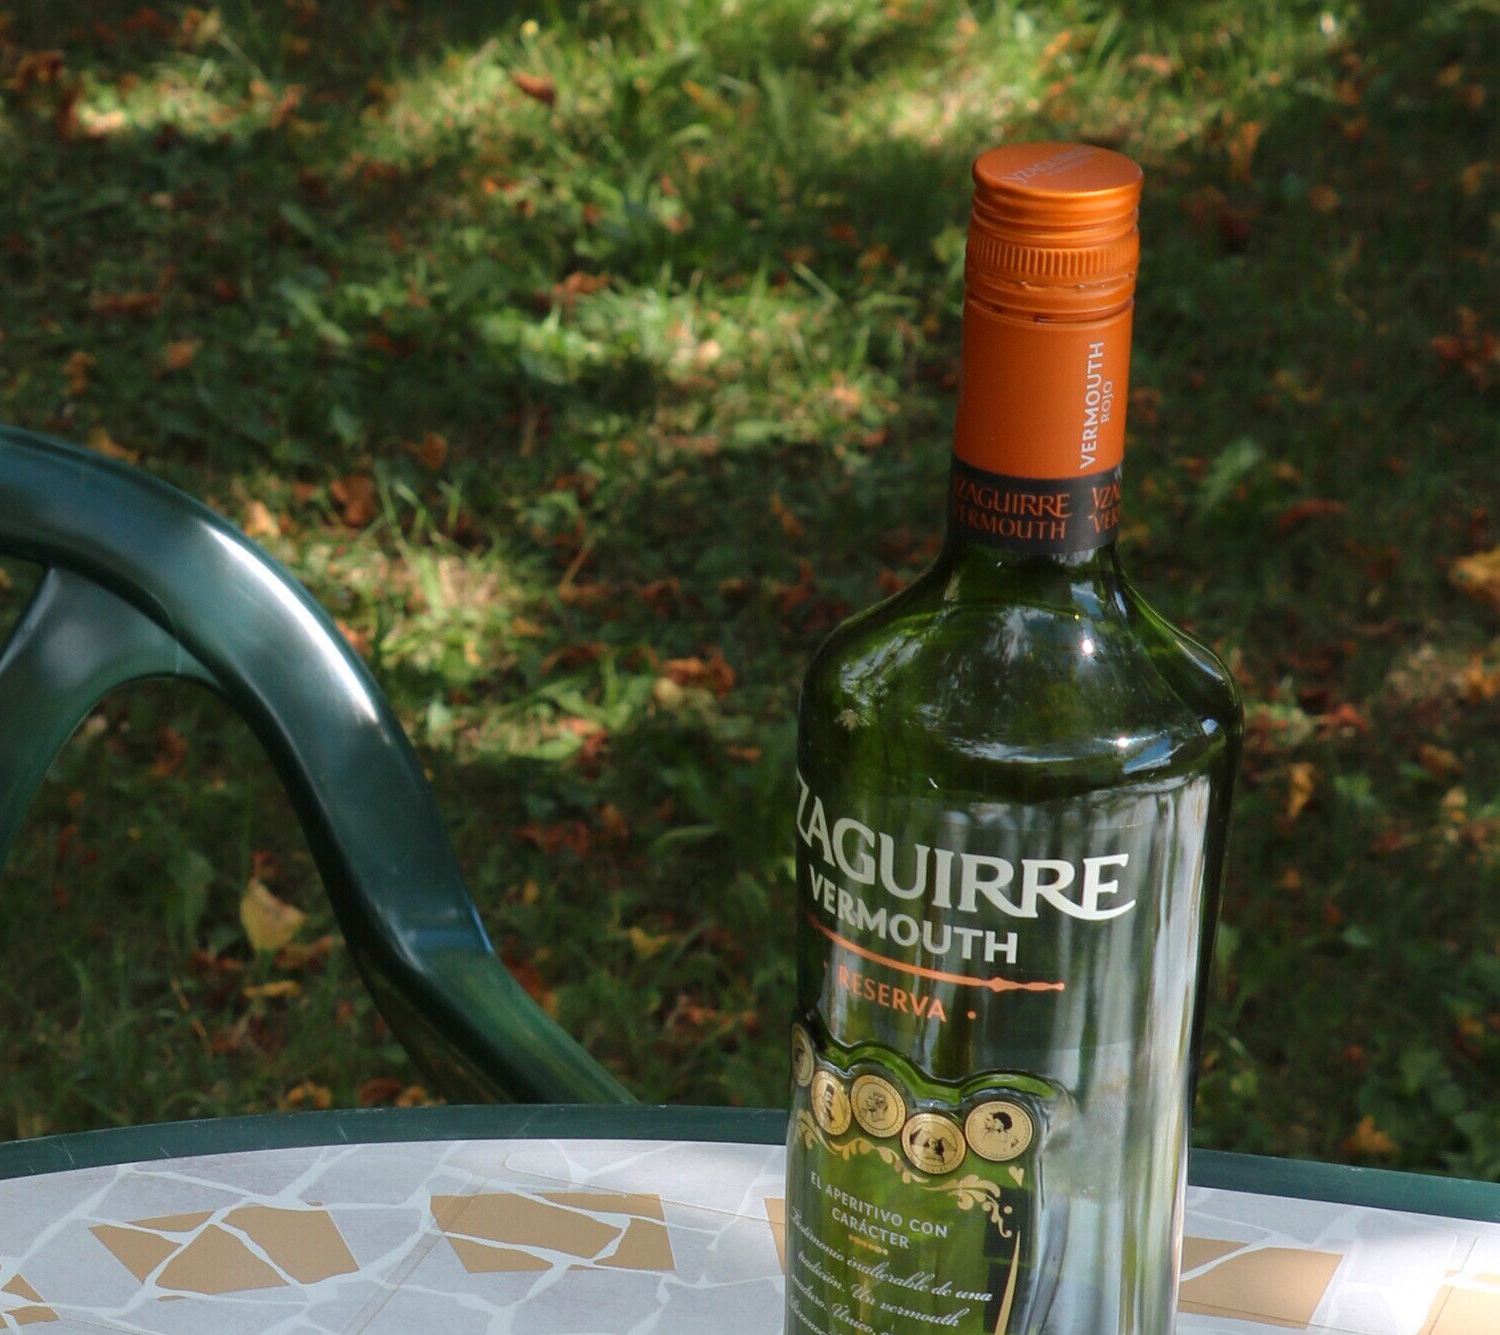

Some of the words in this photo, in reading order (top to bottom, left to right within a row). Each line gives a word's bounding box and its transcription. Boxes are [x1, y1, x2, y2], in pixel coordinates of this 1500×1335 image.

[1079, 341, 1105, 470] VERMOUTH
[1100, 380, 1114, 424] ROJO
[954, 478, 1073, 520] ZAGUIRRE
[796, 765, 1137, 922] ZAGUIRRE
[809, 863, 1019, 965] VERMOUTH
[837, 965, 947, 1023] RESERVA
[810, 1171, 822, 1191] EL
[825, 1183, 904, 1227] APERITIVO
[908, 1219, 949, 1239] CON
[830, 1206, 910, 1250] CARÁCTER
[797, 1250, 846, 1293] tradición.
[850, 1283, 877, 1306] Un
[879, 1300, 971, 1328] vermouth
[846, 1257, 936, 1293] inalterable
[931, 1280, 953, 1298] de
[955, 1289, 994, 1302] una
